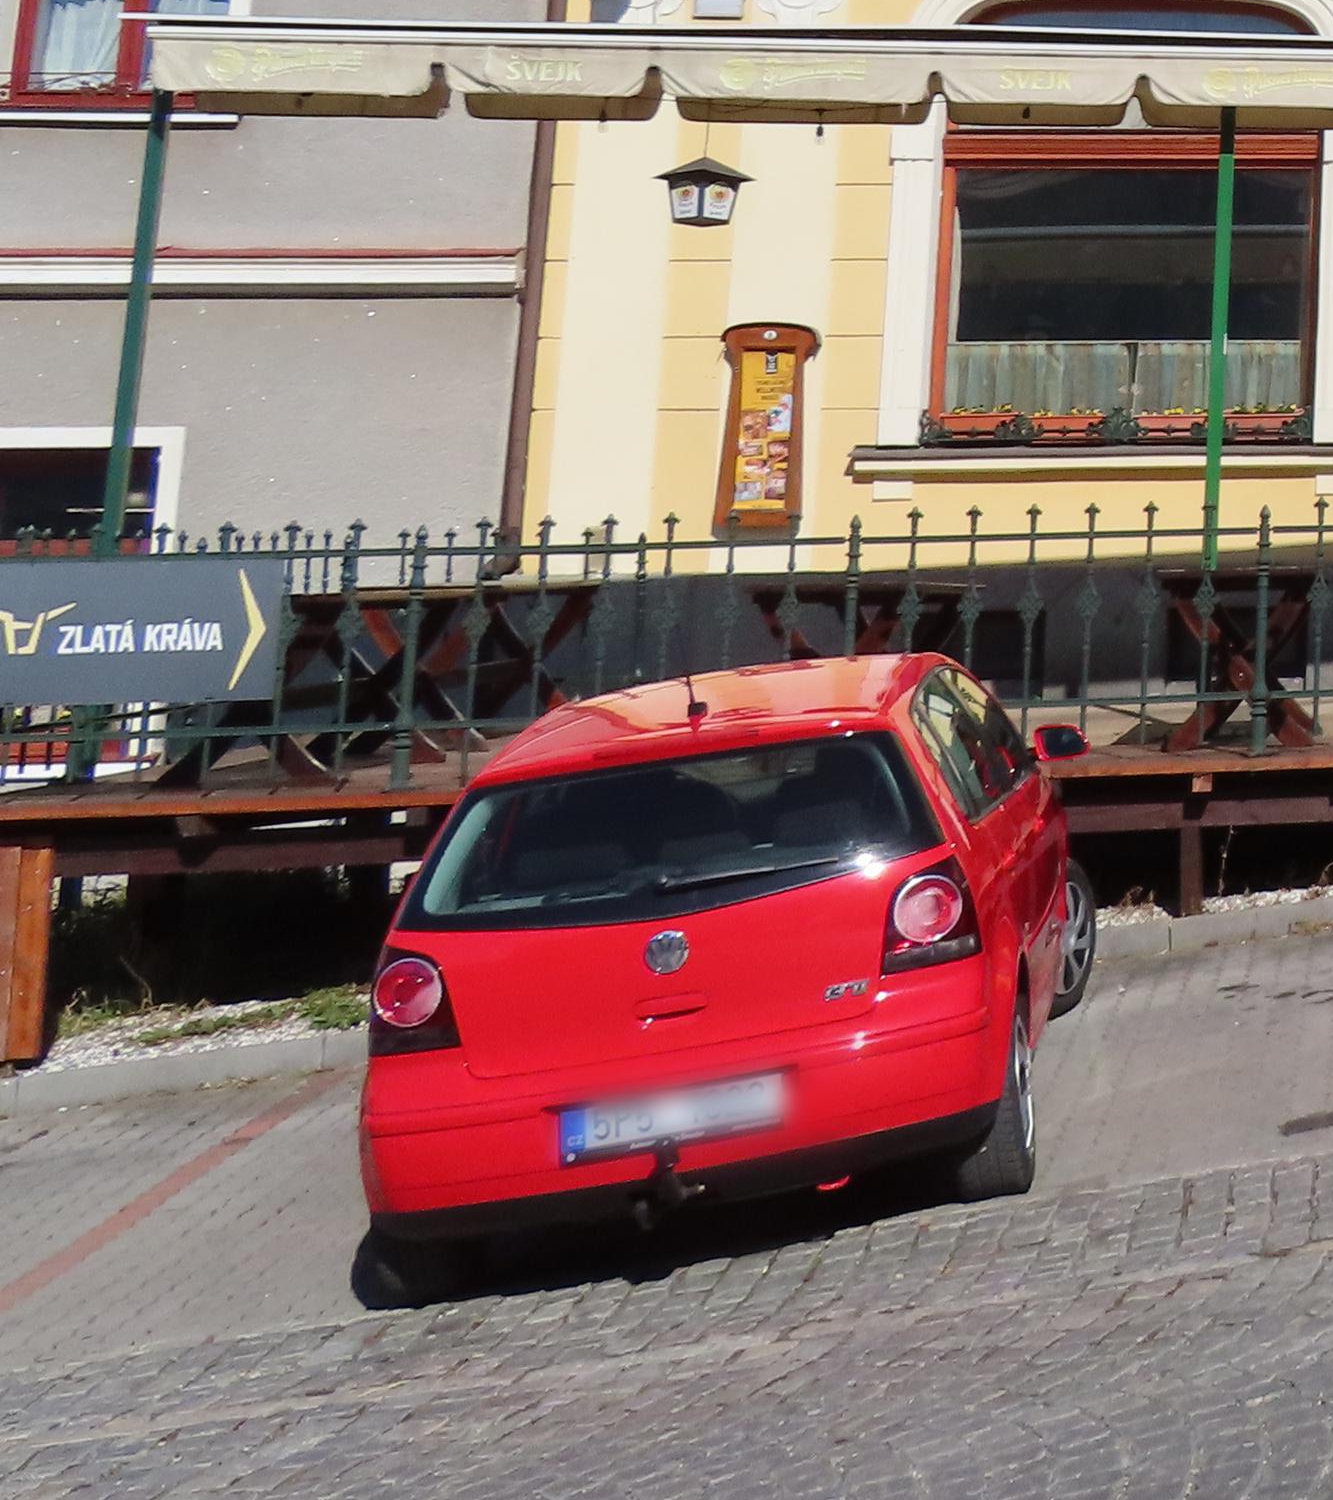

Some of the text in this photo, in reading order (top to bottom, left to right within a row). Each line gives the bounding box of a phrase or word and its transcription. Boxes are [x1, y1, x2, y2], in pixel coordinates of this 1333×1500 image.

[505, 54, 583, 82] ŠVEJK
[56, 618, 224, 655] ZLATÁ KRÁVA
[566, 1133, 585, 1147] CZ
